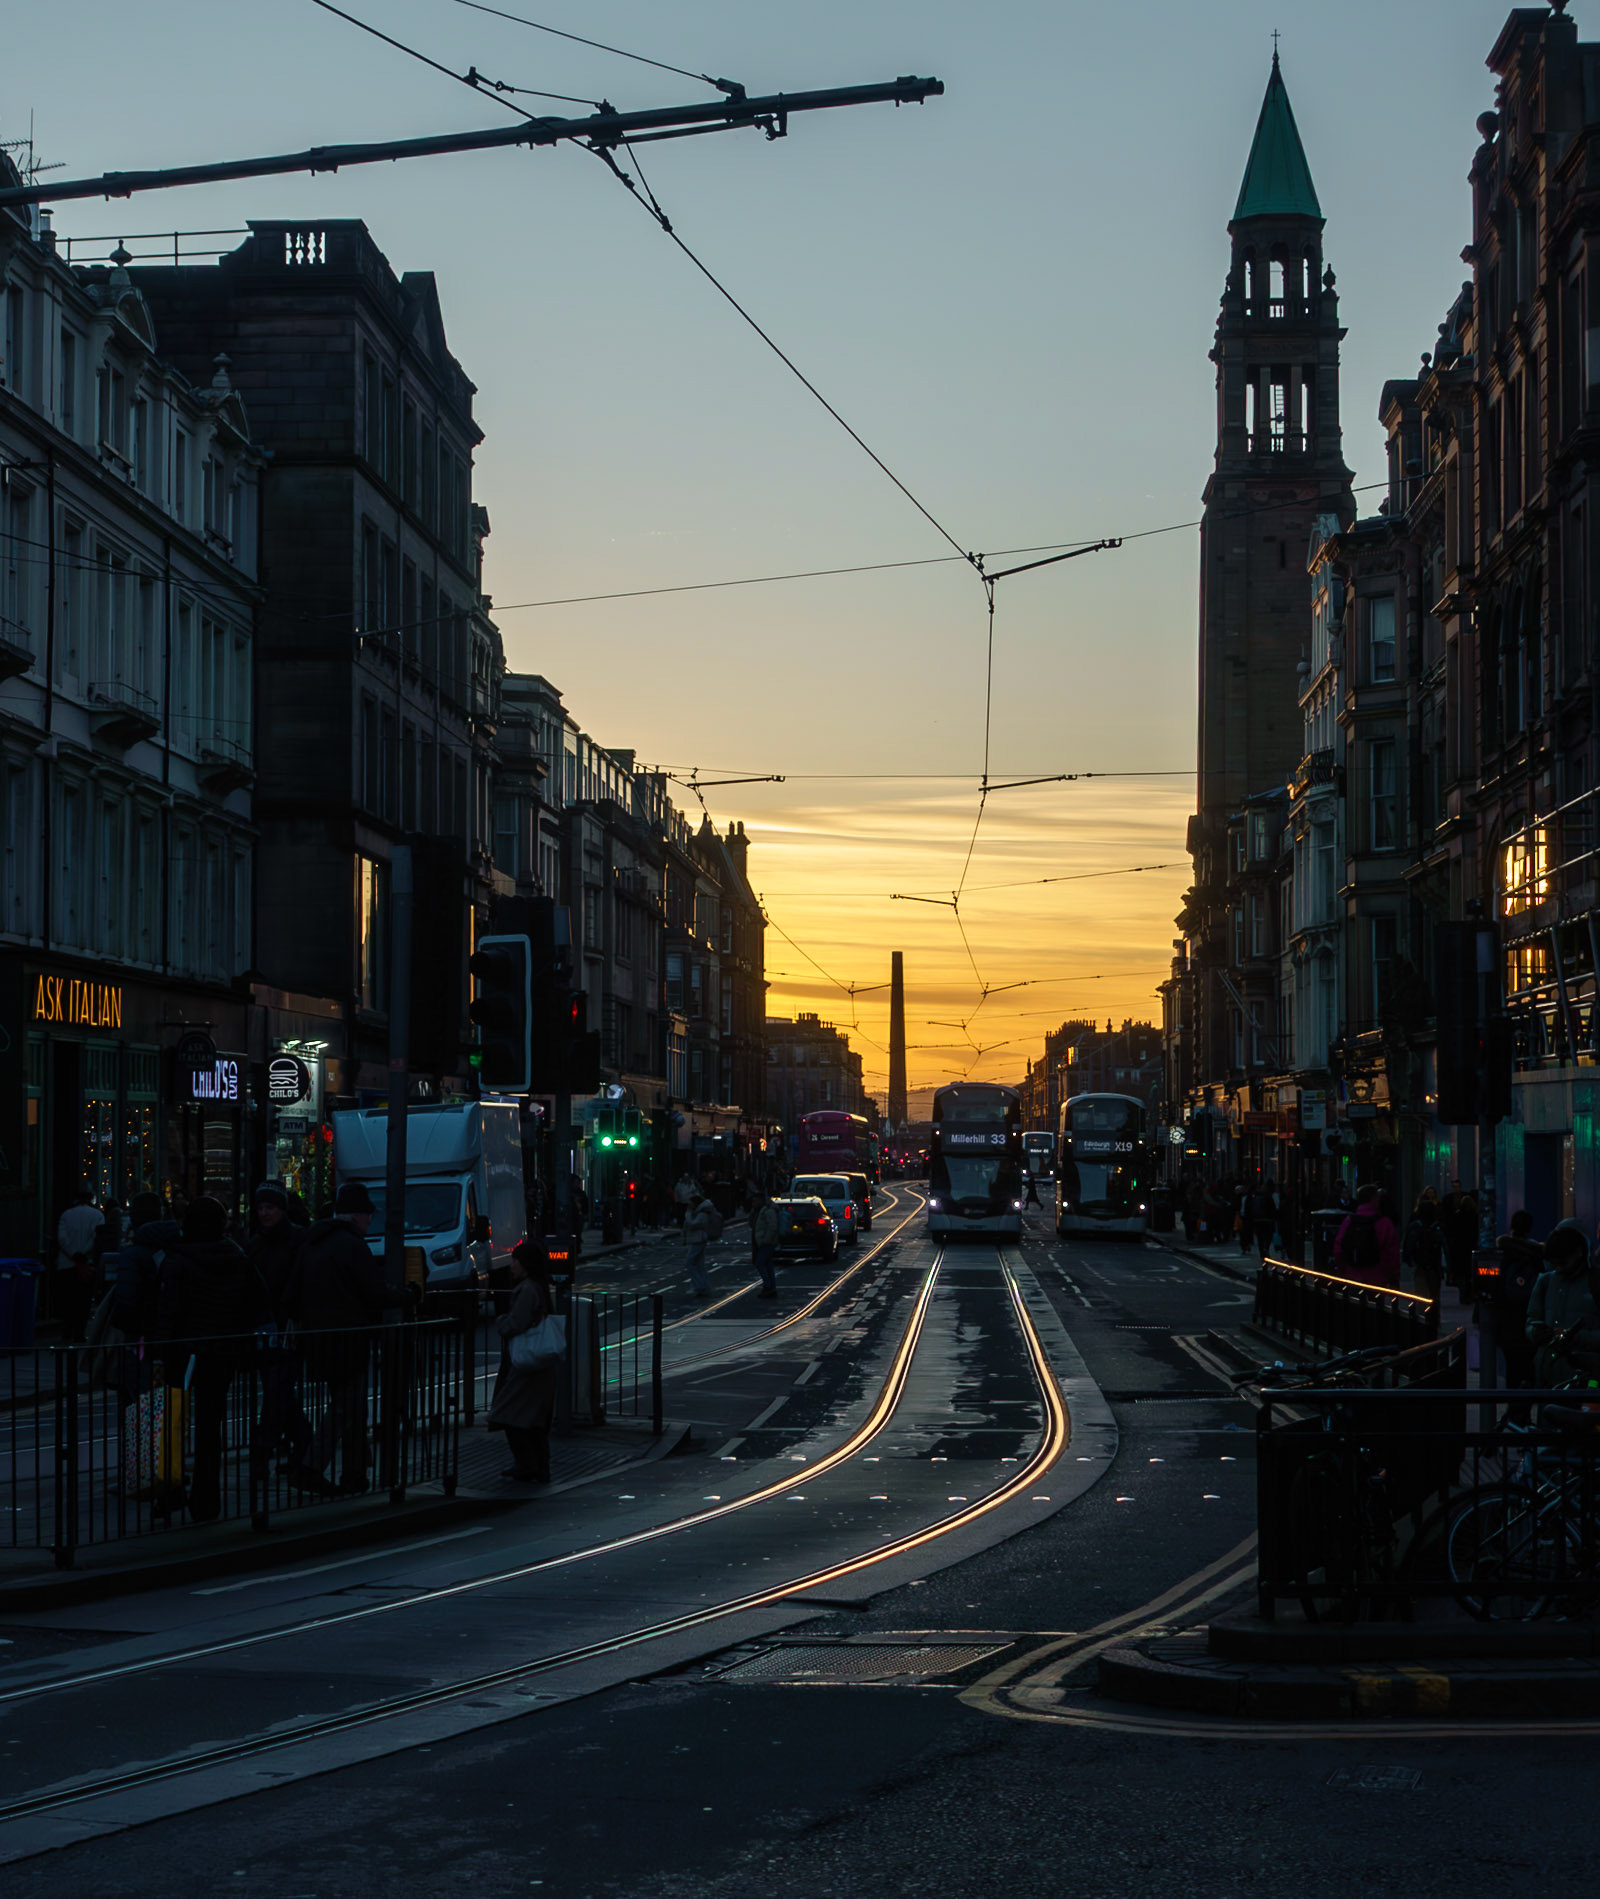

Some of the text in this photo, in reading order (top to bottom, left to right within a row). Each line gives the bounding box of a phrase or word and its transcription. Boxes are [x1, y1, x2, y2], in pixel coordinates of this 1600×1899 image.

[35, 974, 122, 1029] ASK ITALIAN
[269, 1089, 299, 1099] CHILO'S
[283, 1122, 303, 1130] ATM
[951, 1133, 1006, 1144] Millerhill 33
[1114, 1141, 1133, 1152] X19
[548, 1251, 568, 1261] WAIT
